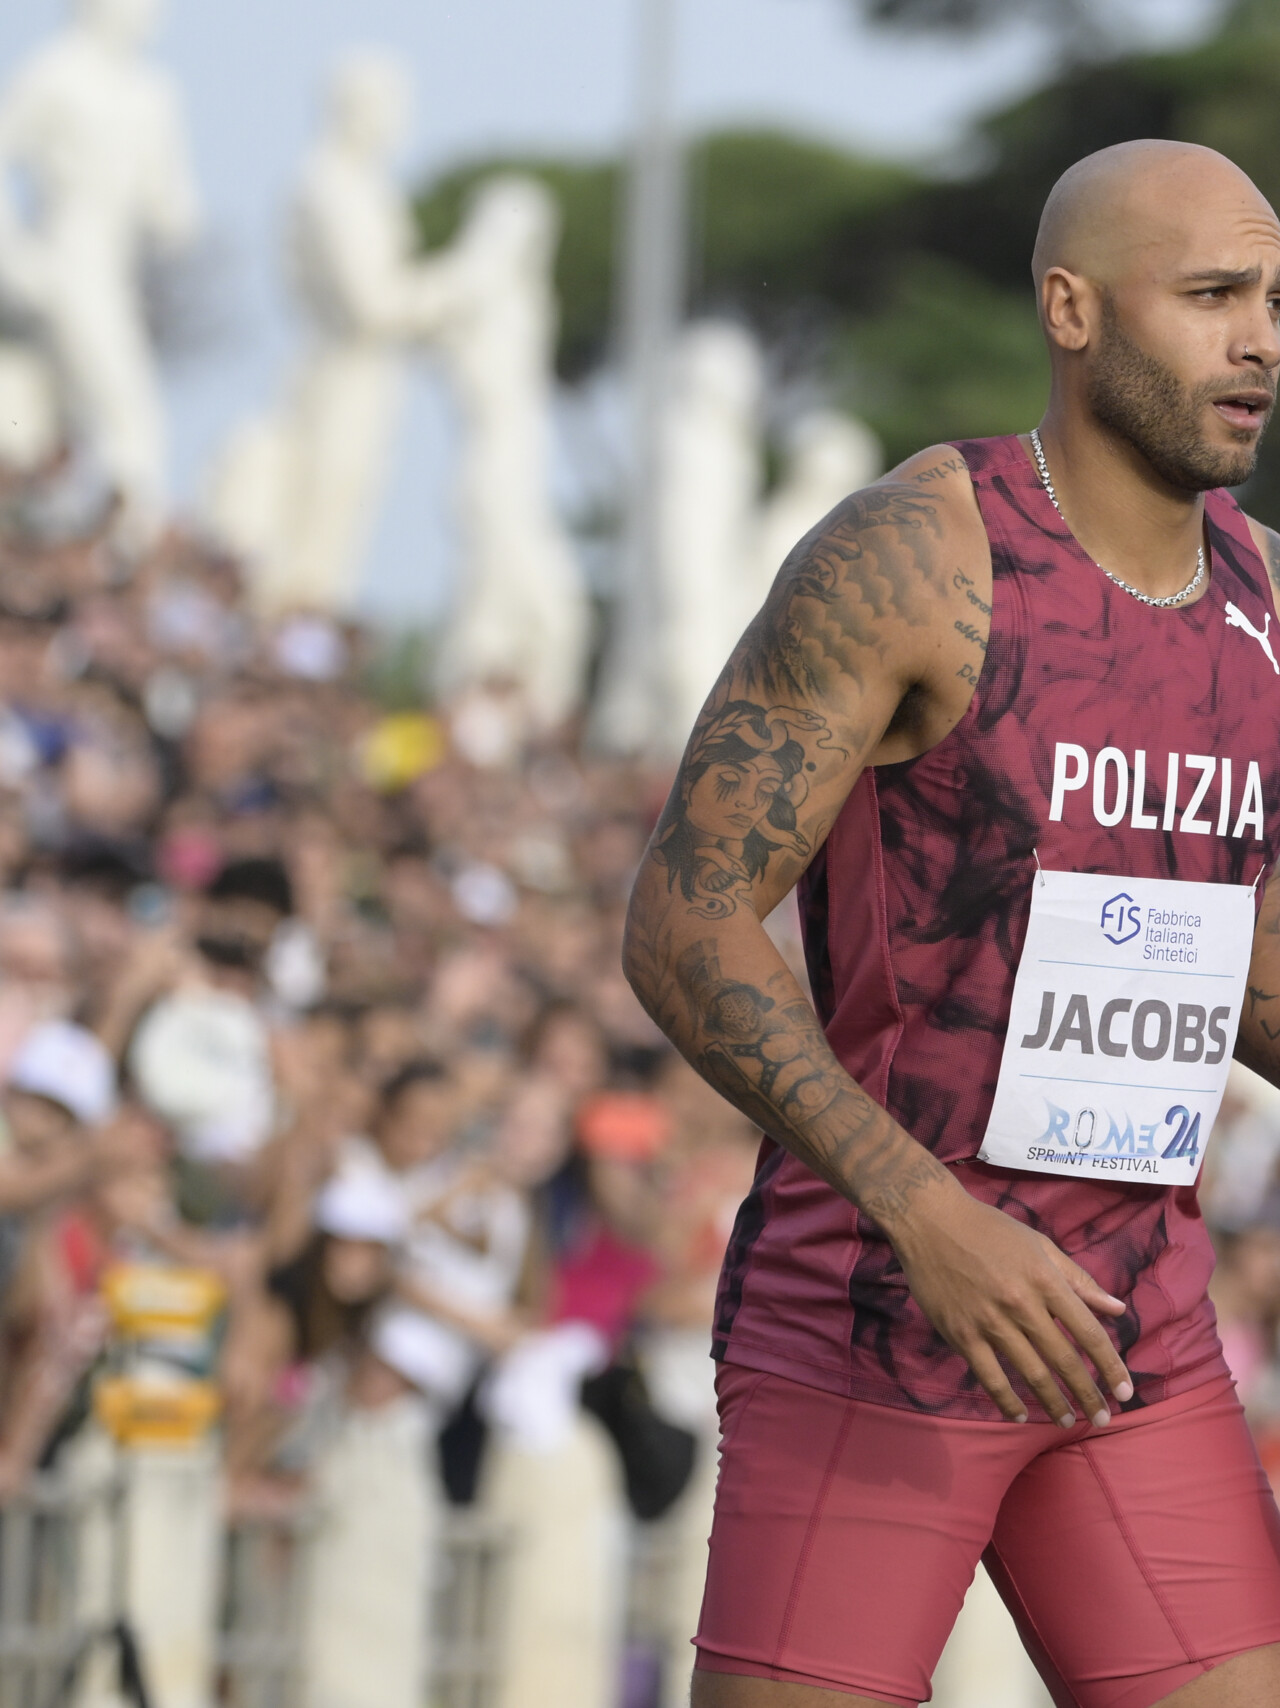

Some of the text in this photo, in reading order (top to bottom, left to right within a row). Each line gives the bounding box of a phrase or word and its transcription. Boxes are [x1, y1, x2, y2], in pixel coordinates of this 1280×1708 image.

[1048, 741, 1265, 841] POLIZIA
[1100, 892, 1142, 946] FIS
[1147, 907, 1202, 928] Fabbrica
[1144, 926, 1194, 946] Italiana
[1142, 944, 1199, 964] Sintetici
[1020, 991, 1232, 1065] JACOBS
[1091, 1154, 1160, 1174] FESTIVAL
